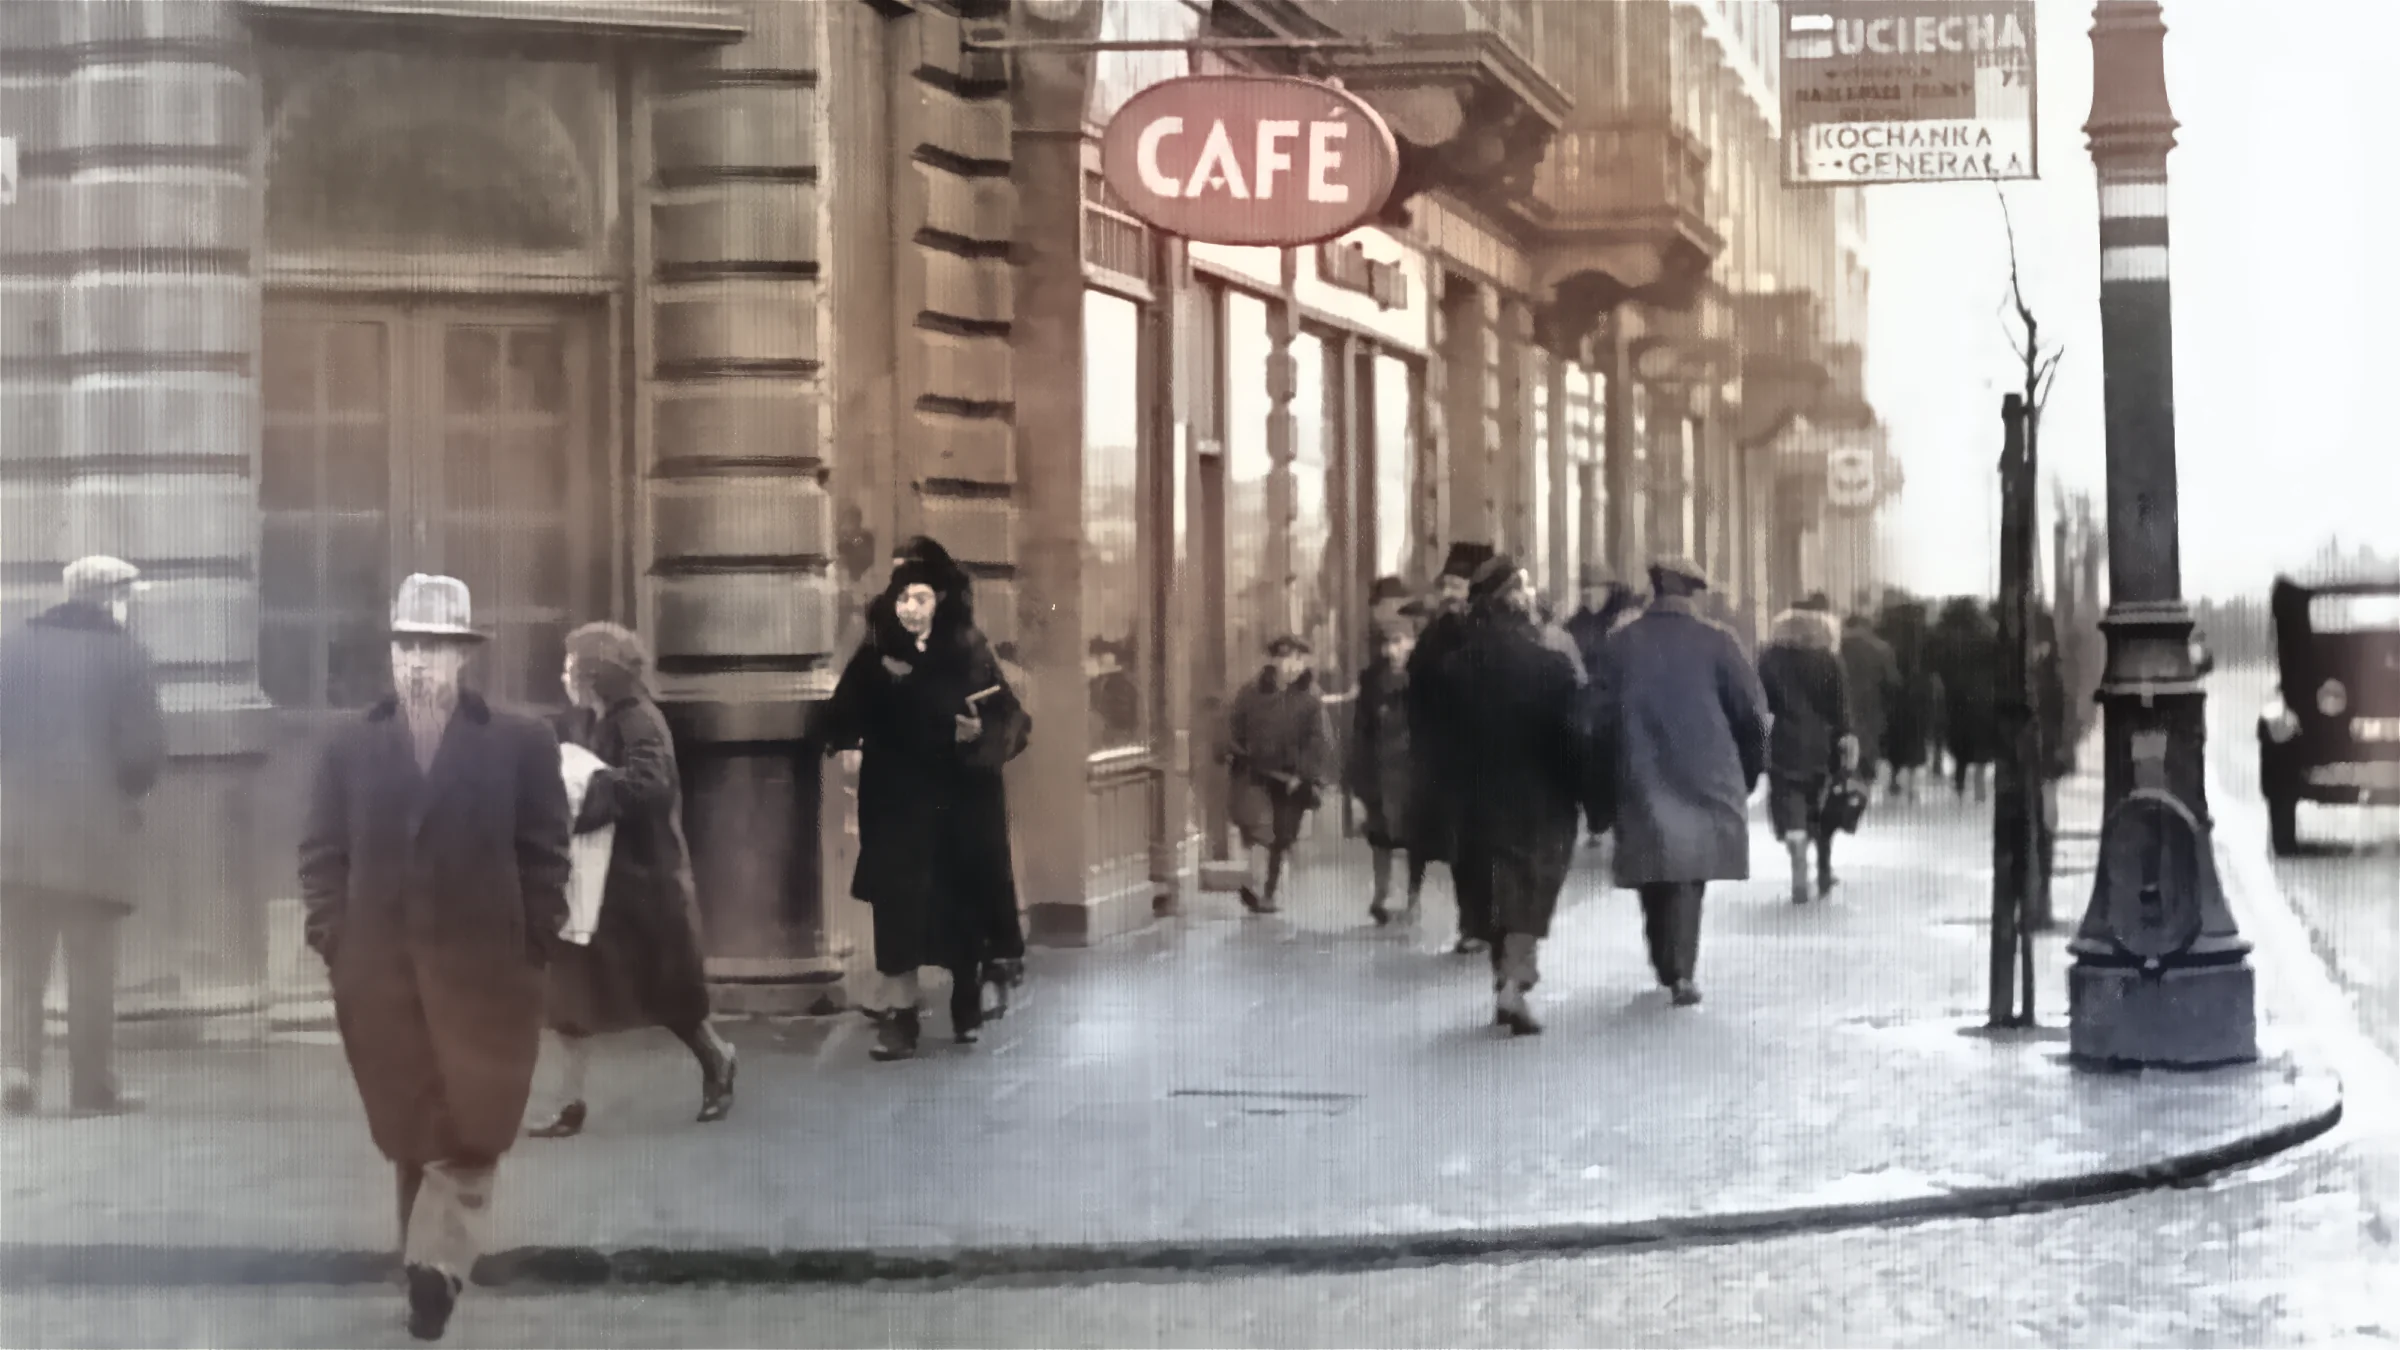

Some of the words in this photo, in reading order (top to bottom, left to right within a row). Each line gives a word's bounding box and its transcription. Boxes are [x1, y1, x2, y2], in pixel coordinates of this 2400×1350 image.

[1837, 14, 2026, 54] UCIECHA
[1137, 105, 1349, 203] CAFÉ
[1816, 126, 1992, 150] KOCHANKA
